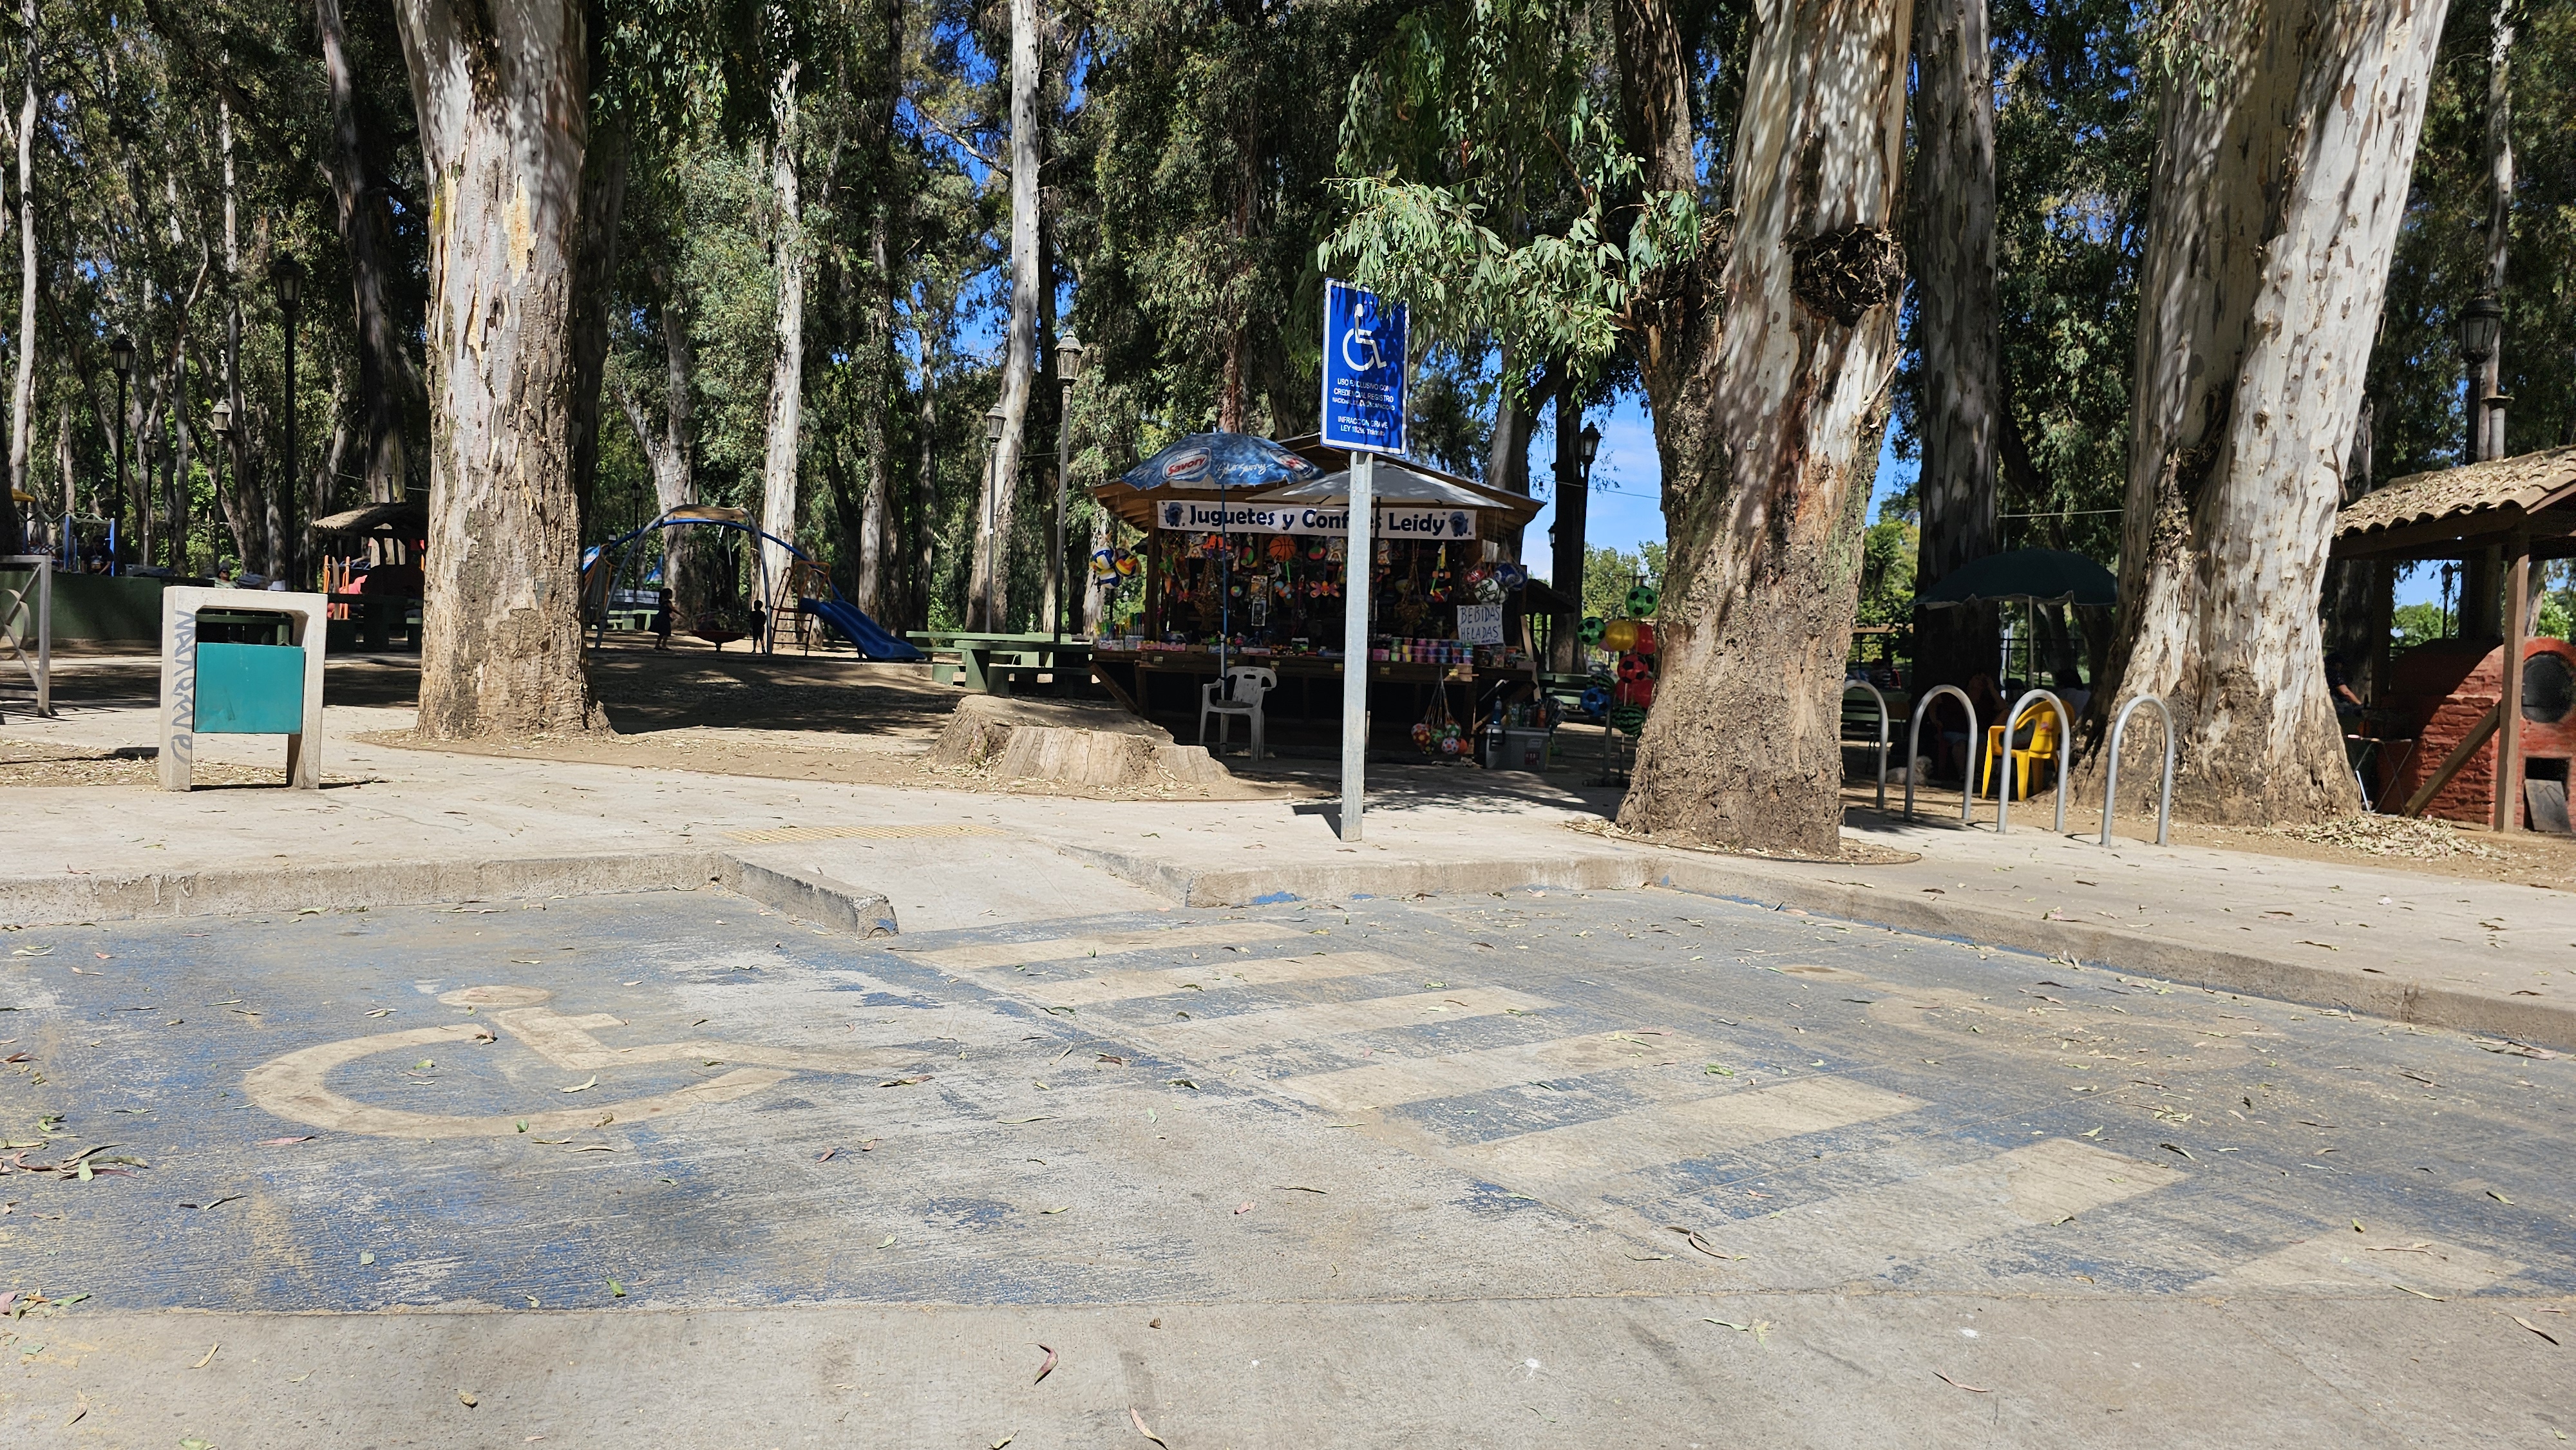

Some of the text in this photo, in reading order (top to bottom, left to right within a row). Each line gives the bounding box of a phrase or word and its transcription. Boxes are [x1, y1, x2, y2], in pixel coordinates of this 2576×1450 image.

[1338, 378, 1349, 386] USO
[1367, 393, 1394, 403] REGISTRO
[1370, 420, 1388, 429] GRAVE
[1168, 457, 1206, 475] Savory
[1189, 505, 1275, 527] Juguetes
[1282, 513, 1294, 531] y
[1388, 512, 1445, 536] Leidy
[1460, 606, 1501, 625] BEBIDAS
